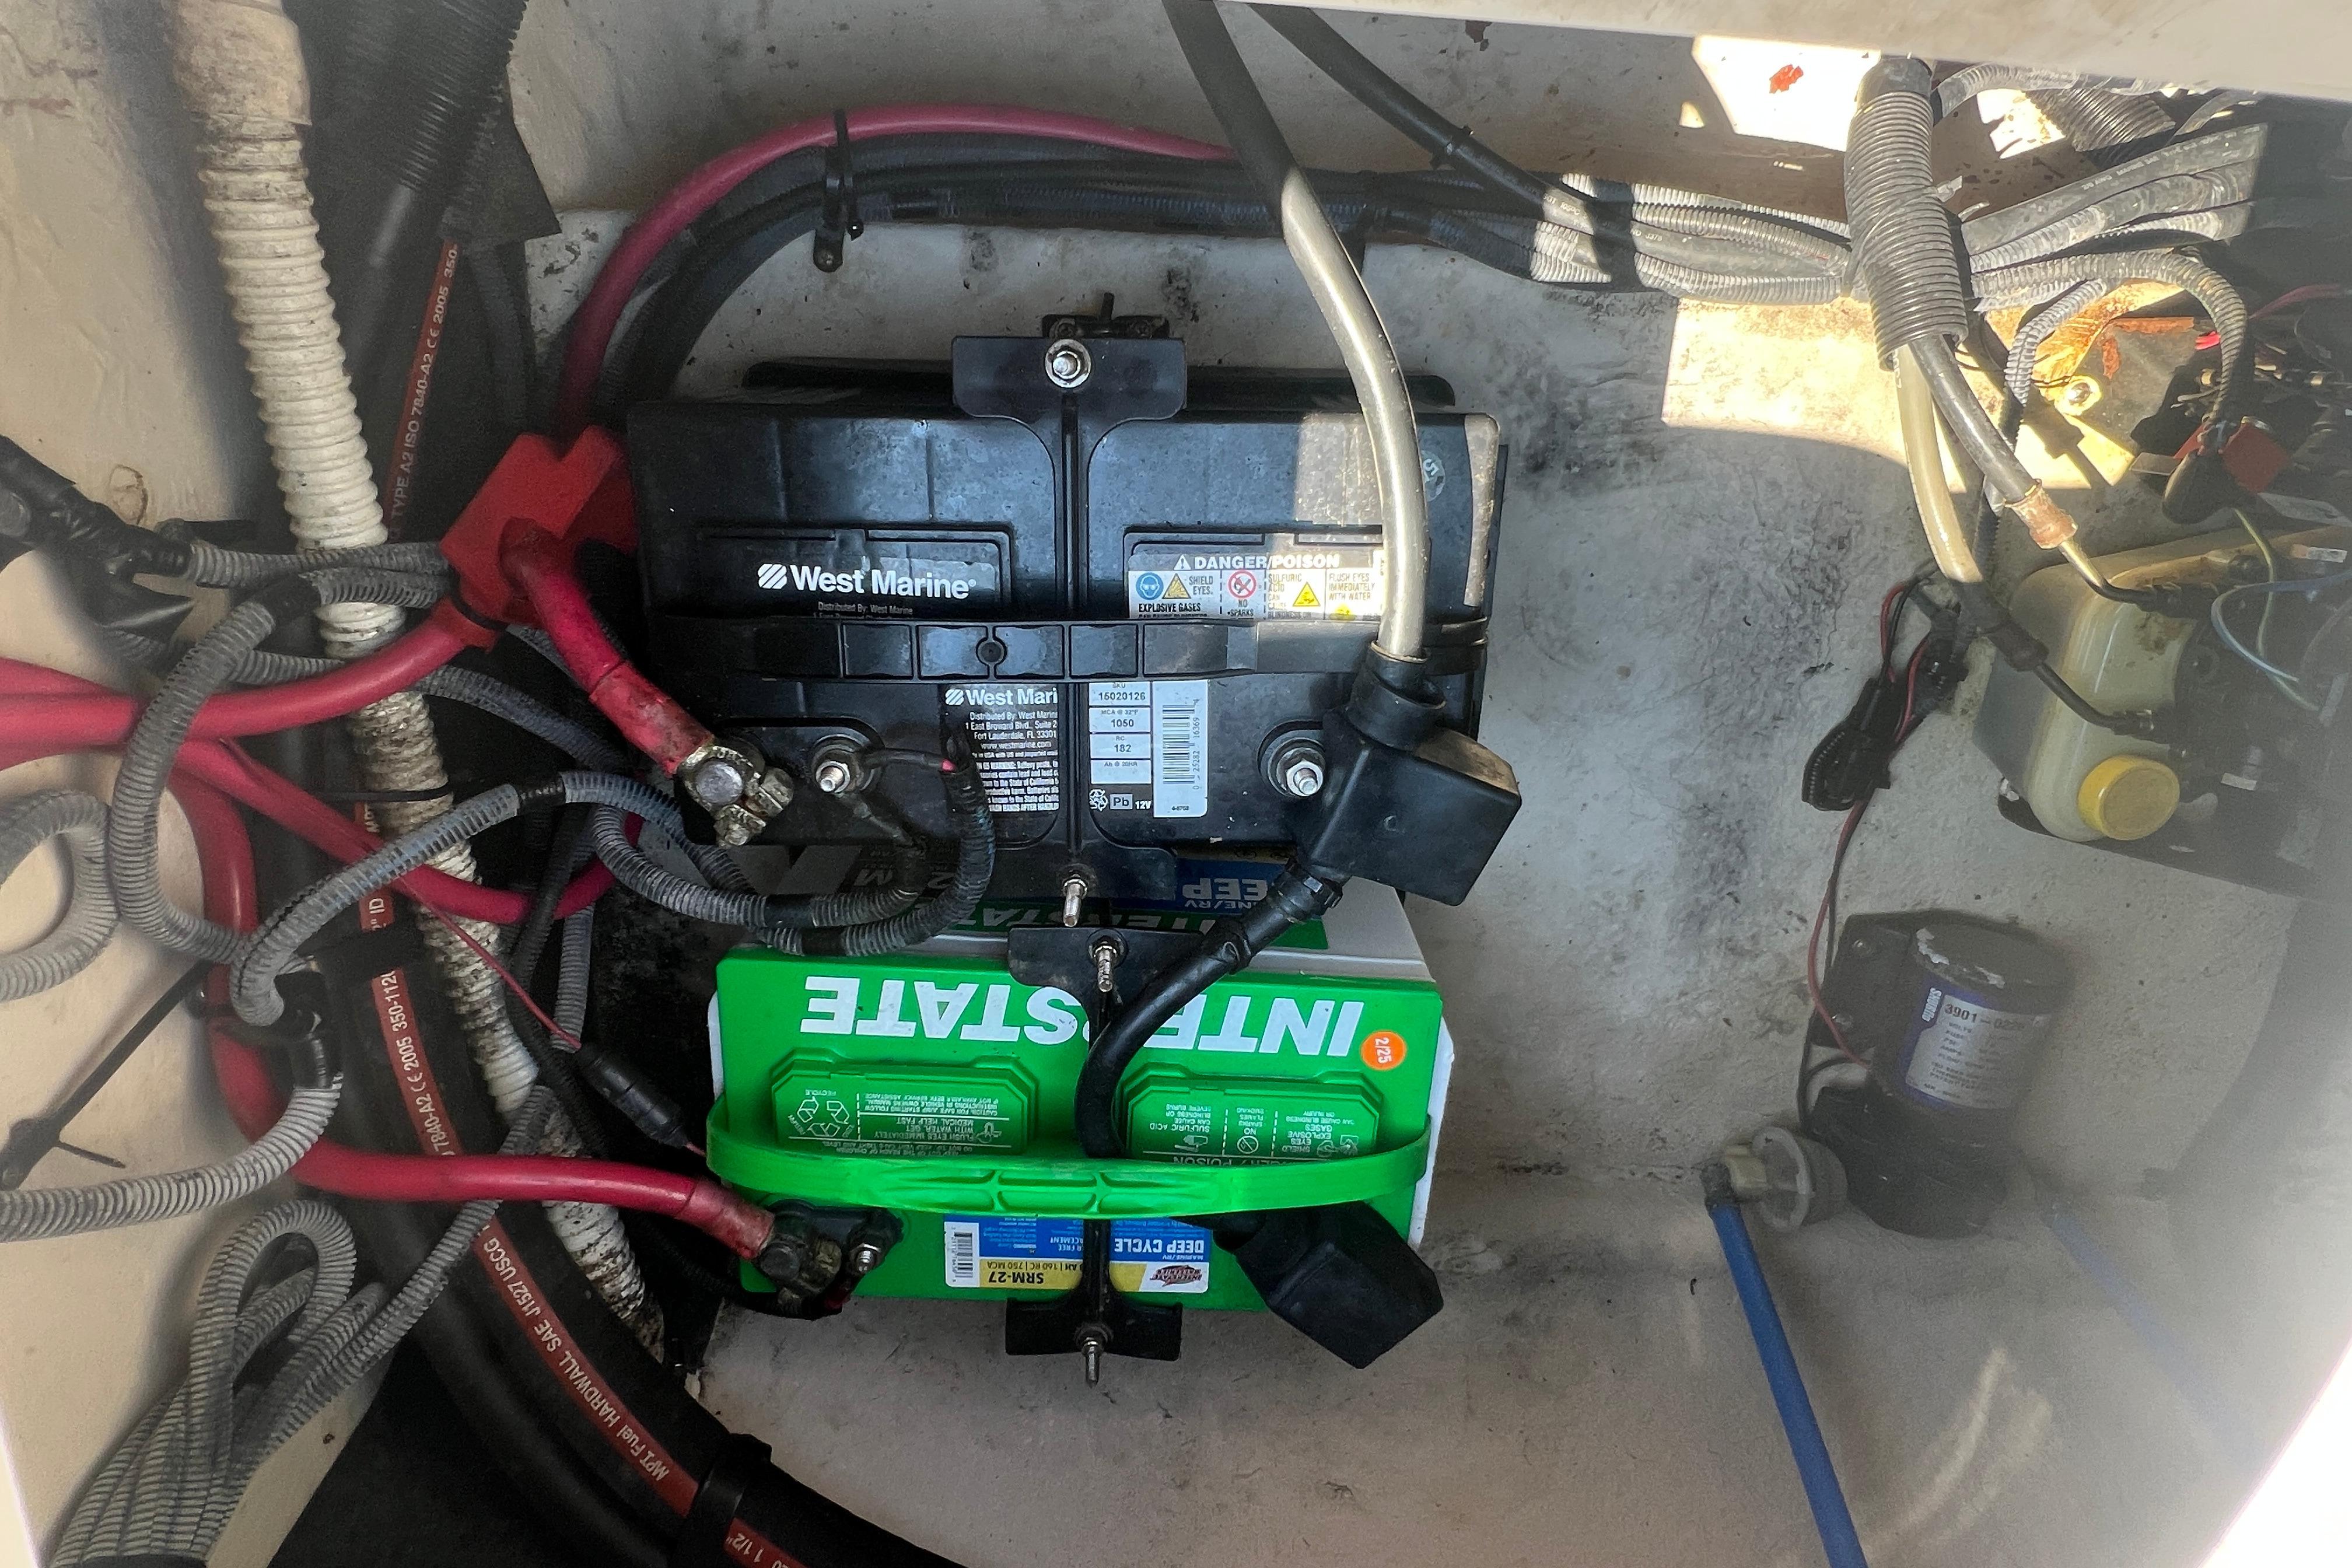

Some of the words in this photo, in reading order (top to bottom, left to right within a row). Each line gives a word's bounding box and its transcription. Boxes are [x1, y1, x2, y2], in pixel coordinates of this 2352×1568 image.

[433, 285, 449, 324] 2005
[411, 354, 434, 416] 7840-A2
[404, 420, 420, 448] ISO
[790, 565, 864, 594] West
[871, 569, 970, 600] Marine
[1189, 576, 1213, 586] SHIELD
[1268, 573, 1302, 582] SULFURIC
[1329, 573, 1350, 582] FLUSH
[1353, 573, 1370, 582] EYES
[1268, 583, 1284, 592] ACID
[1329, 583, 1375, 591] IMMEDIATELY
[1329, 592, 1346, 600] WITH
[1139, 603, 1176, 612] EXPLOSIVE
[1178, 603, 1201, 612] GASES
[1238, 600, 1248, 608] NO
[965, 689, 1014, 706] West
[1017, 687, 1058, 705] Mari
[1098, 692, 1146, 701] 15020126
[970, 712, 1005, 720] Distributed
[1111, 719, 1134, 727] 1050
[1027, 730, 1035, 738] FL
[1037, 730, 1056, 738] 33301
[1114, 744, 1132, 752] 182
[1113, 797, 1129, 806] Pb
[1135, 800, 1152, 810] 12V
[1182, 877, 1268, 901] EEP
[369, 898, 385, 914] ID
[800, 975, 1365, 1057] INTESTATE
[396, 1036, 419, 1071] 2005
[1374, 1036, 1390, 1065] 2/25
[1149, 1122, 1168, 1130] ACID
[1171, 1124, 1210, 1133] SULFURIC
[1305, 1124, 1332, 1132] GASES
[874, 1131, 925, 1140] IMMEDIATELY
[1287, 1131, 1331, 1139] EXPLOSIVE
[1114, 1238, 1163, 1253] CYCLE
[1167, 1239, 1204, 1253] DEEP
[483, 1237, 516, 1282] USCG
[1043, 1262, 1058, 1270] 160
[988, 1271, 1044, 1284] SRM-27
[508, 1280, 541, 1316] J1527
[534, 1319, 562, 1353] SAE
[559, 1350, 621, 1428] HARDWALL
[616, 1424, 646, 1457] Fuel
[639, 1450, 670, 1482] MPI
